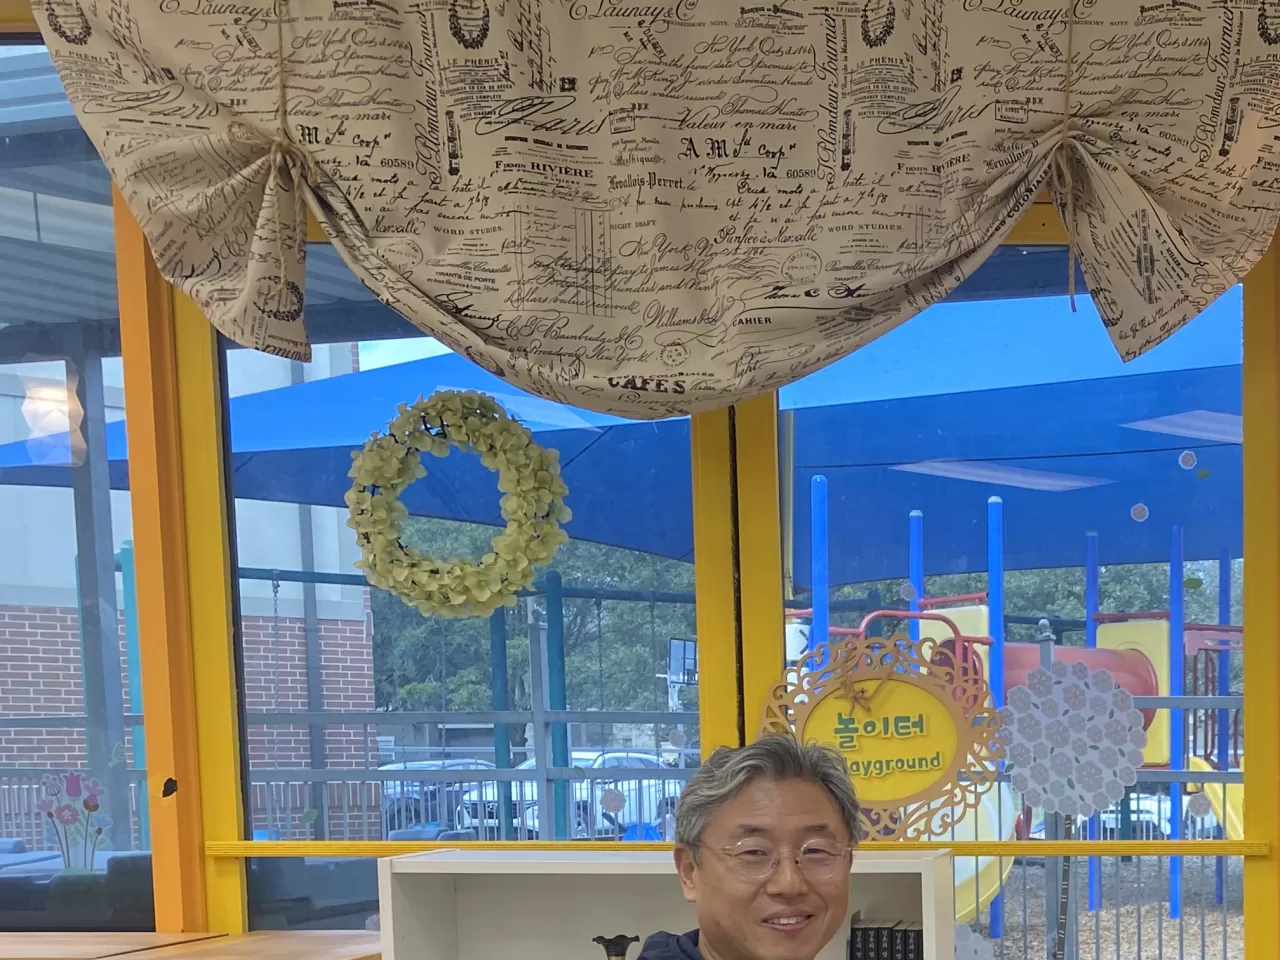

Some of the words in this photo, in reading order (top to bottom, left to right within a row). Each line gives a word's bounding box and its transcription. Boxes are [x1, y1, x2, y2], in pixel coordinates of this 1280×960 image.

[531, 161, 594, 178] RIVIÈRE
[1179, 195, 1207, 209] WORD
[433, 226, 464, 235] WORD
[635, 220, 658, 229] DRAFT
[828, 225, 854, 233] WORD
[435, 271, 462, 279] TIRANTS
[474, 276, 496, 284] PORTE
[732, 316, 774, 328] CAHIER
[834, 712, 924, 749] 놀이터
